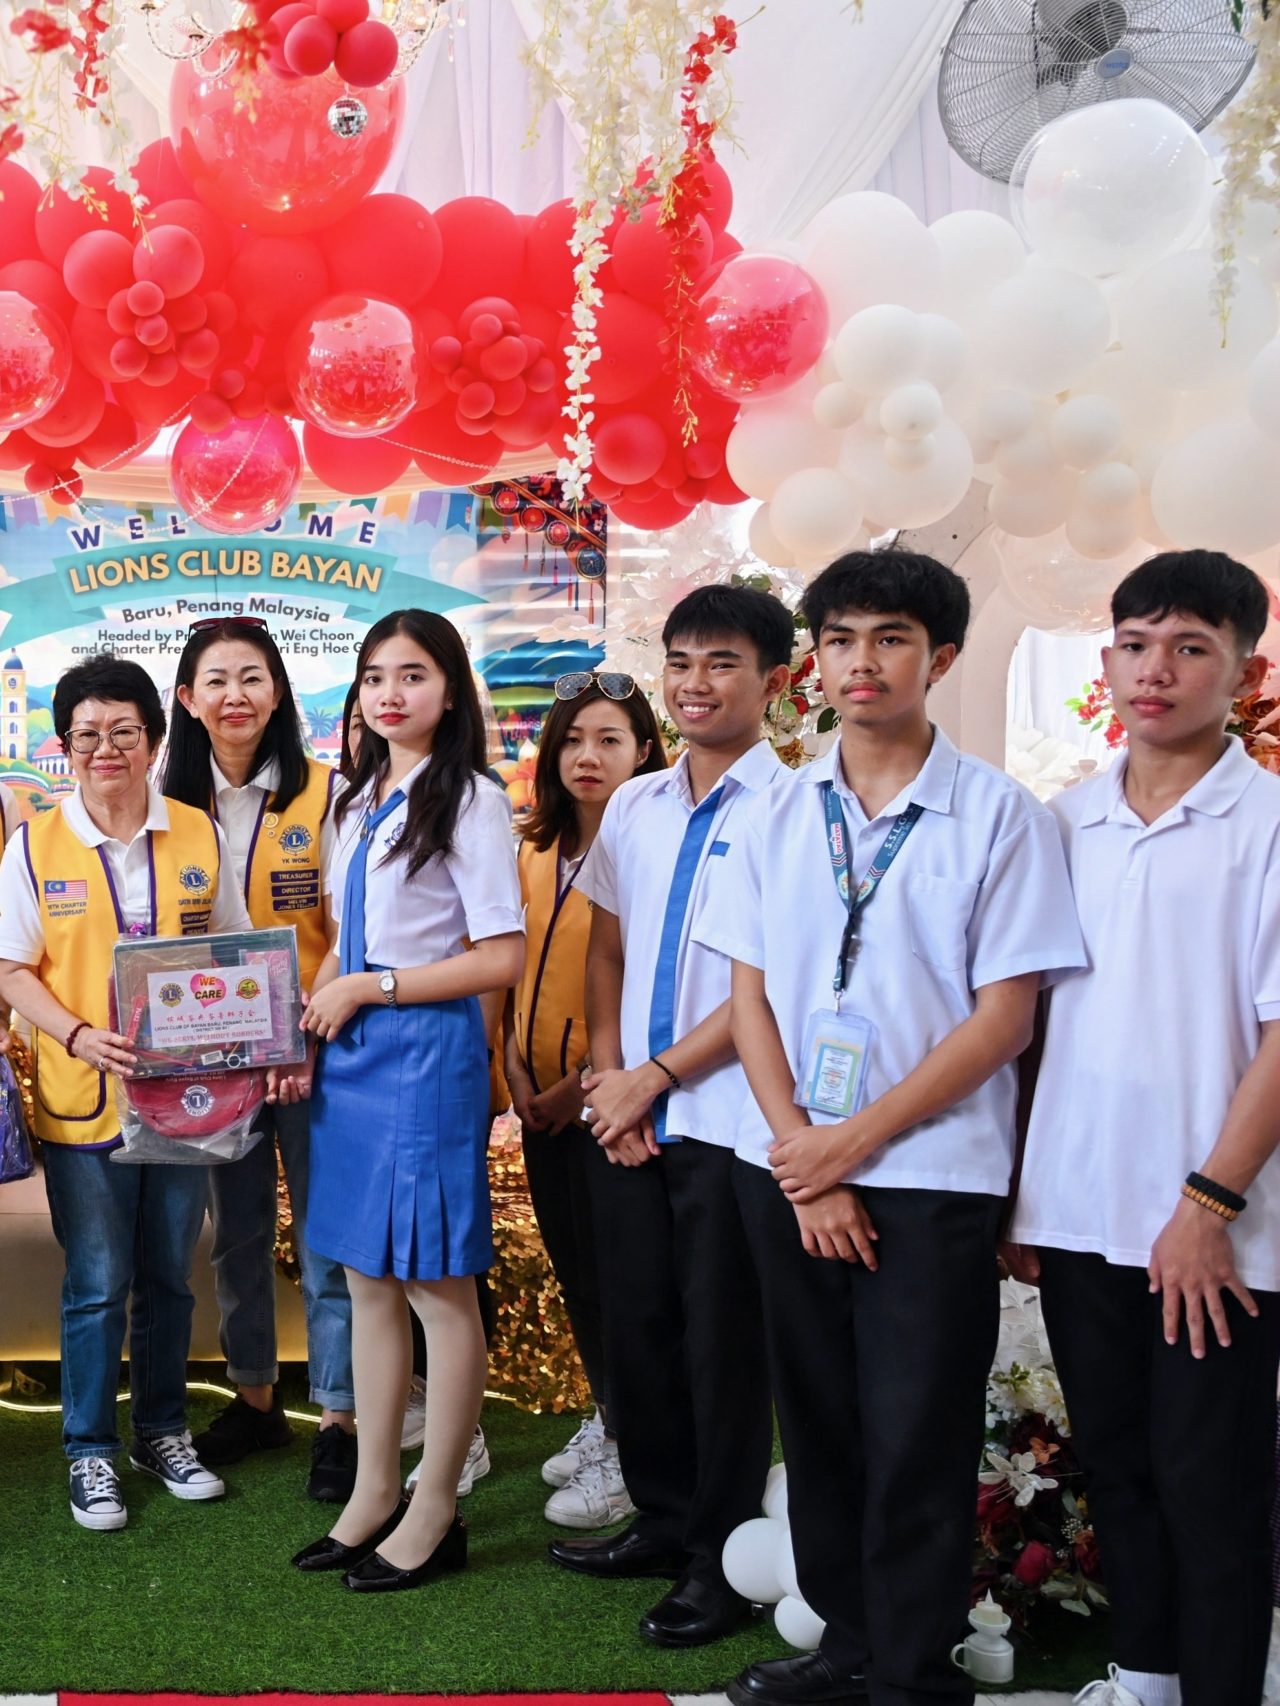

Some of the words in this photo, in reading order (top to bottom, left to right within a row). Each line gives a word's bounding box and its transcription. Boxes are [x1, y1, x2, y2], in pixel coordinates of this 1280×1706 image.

[69, 553, 170, 594] LIONS
[177, 550, 261, 577] CLUB
[271, 551, 382, 593] BAYAN
[122, 606, 172, 623] Baru,
[176, 599, 244, 615] Penang
[249, 598, 330, 622] Malaysia
[98, 629, 150, 641] Headed
[155, 629, 171, 645] by
[280, 629, 306, 641] Wei
[309, 629, 354, 641] Choon
[71, 642, 97, 654] and
[101, 642, 154, 654] Charter
[293, 642, 318, 657] Eng
[322, 642, 349, 654] Hoe
[291, 834, 301, 846] L
[190, 874, 200, 886] L
[278, 872, 313, 880] TREASURER
[281, 886, 312, 894] DIRECTOR
[199, 976, 216, 986] WE
[194, 989, 222, 1000] CARE
